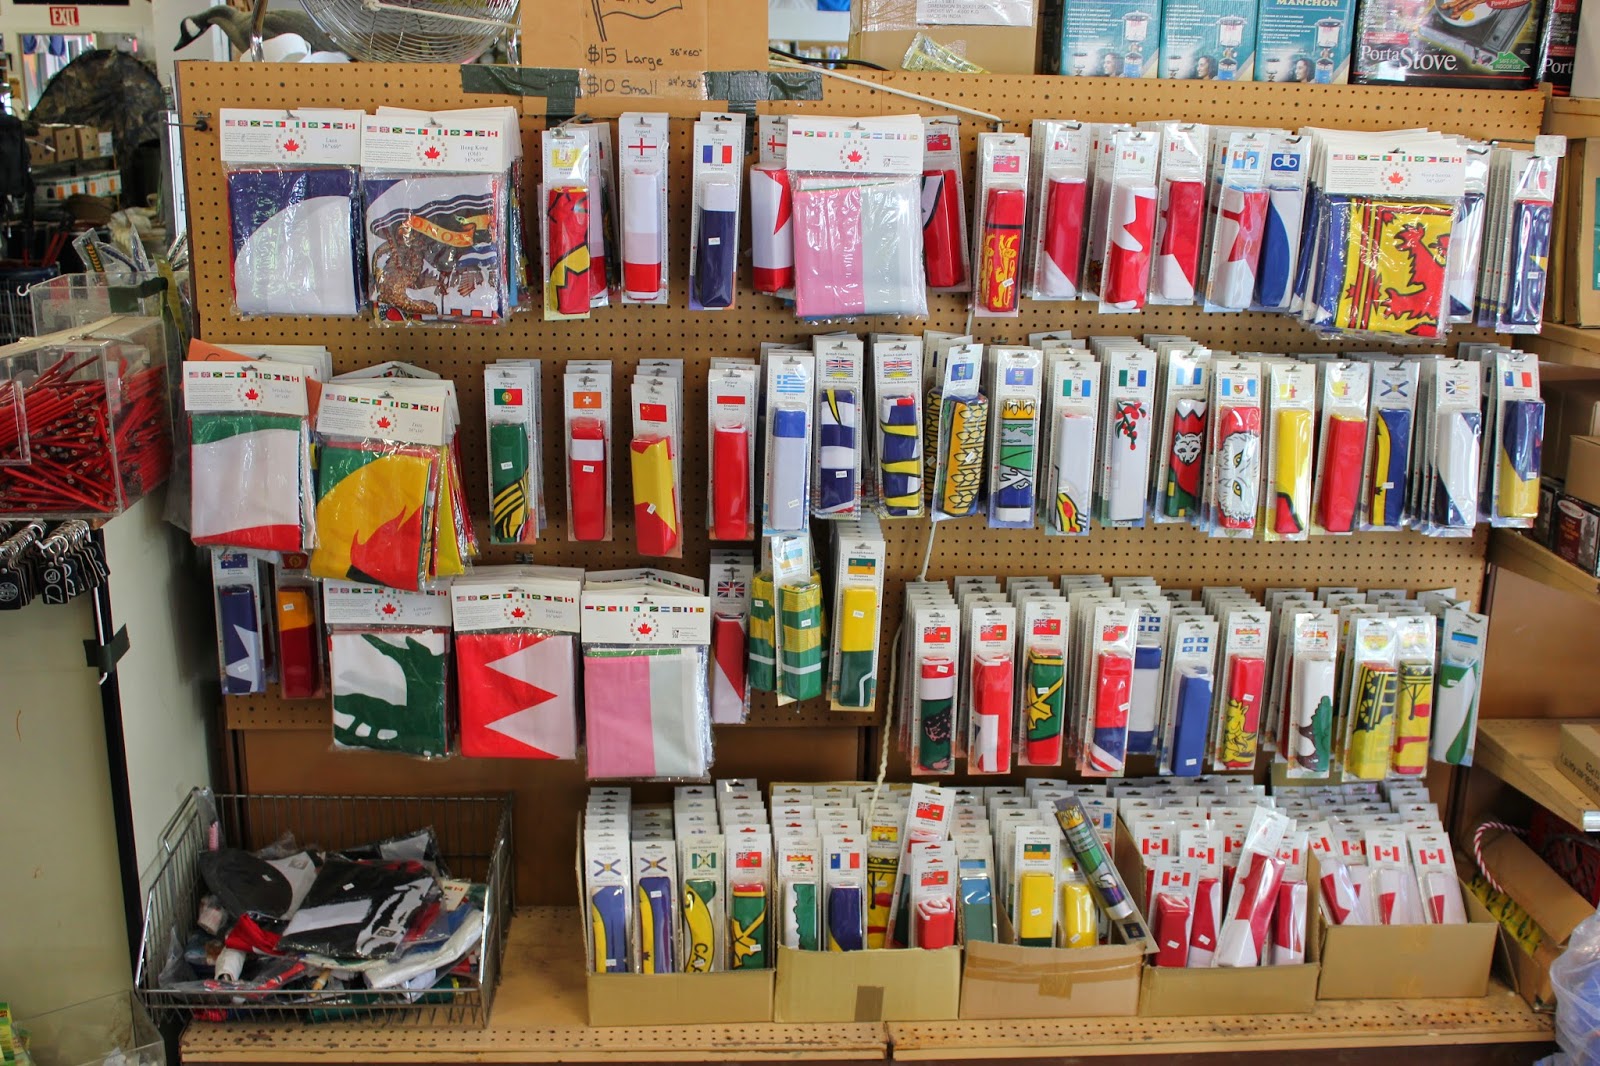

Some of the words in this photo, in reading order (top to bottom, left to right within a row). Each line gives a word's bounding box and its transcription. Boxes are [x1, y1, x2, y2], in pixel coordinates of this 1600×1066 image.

[52, 8, 77, 26] EXIT
[587, 44, 617, 66] $15
[625, 49, 664, 71] Large
[587, 74, 616, 97] $10
[620, 79, 658, 96] Small
